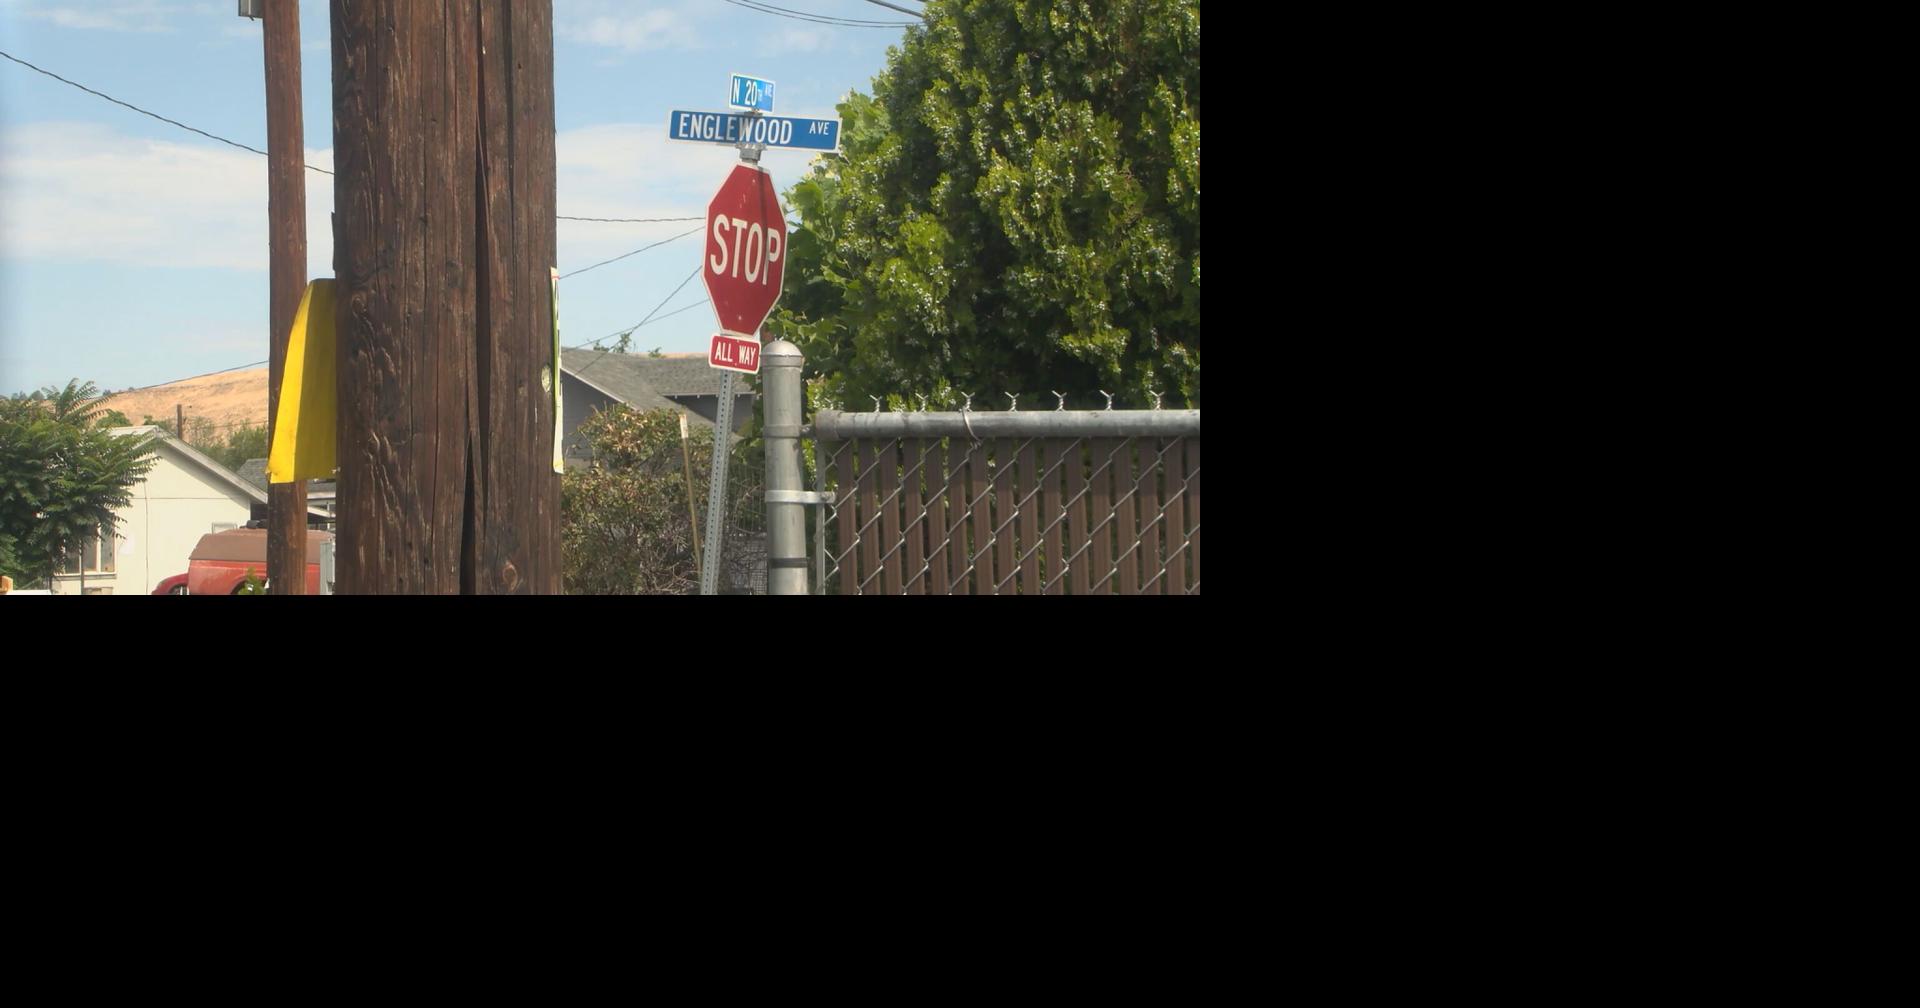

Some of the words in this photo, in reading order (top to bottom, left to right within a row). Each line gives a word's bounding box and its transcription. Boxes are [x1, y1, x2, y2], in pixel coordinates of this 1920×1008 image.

[732, 78, 741, 104] N
[679, 114, 792, 144] ENGLEWOOD
[809, 121, 829, 136] AVE
[710, 214, 781, 285] STOP
[715, 342, 733, 363] ALL
[739, 345, 756, 366] WAY
